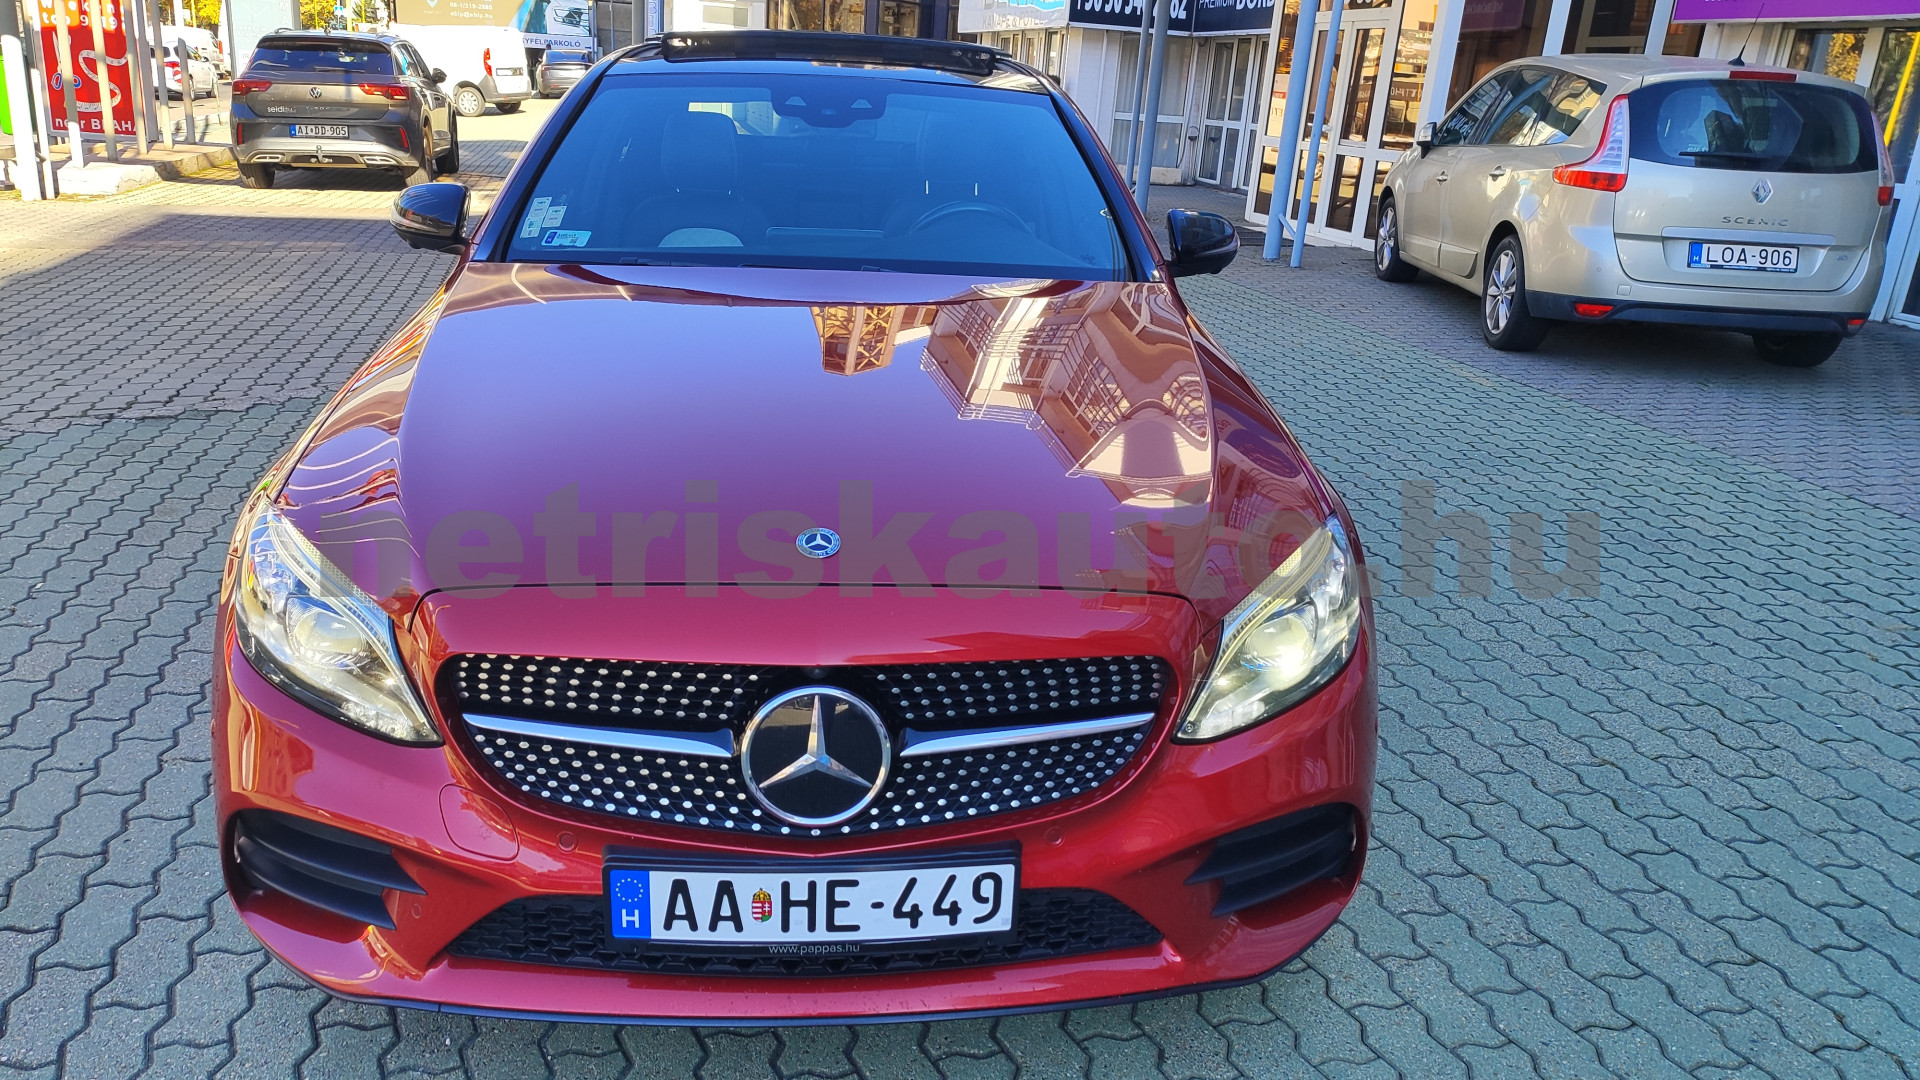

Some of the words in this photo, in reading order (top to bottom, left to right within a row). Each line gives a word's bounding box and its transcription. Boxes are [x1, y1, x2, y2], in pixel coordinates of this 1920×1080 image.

[315, 126, 347, 136] DD-905
[1721, 216, 1789, 227] SCENIC
[1706, 246, 1792, 267] LOA-906
[621, 909, 640, 929] H
[663, 879, 744, 933] AA
[780, 871, 1003, 934] HE-449
[768, 943, 861, 955] www.pappas.hu
